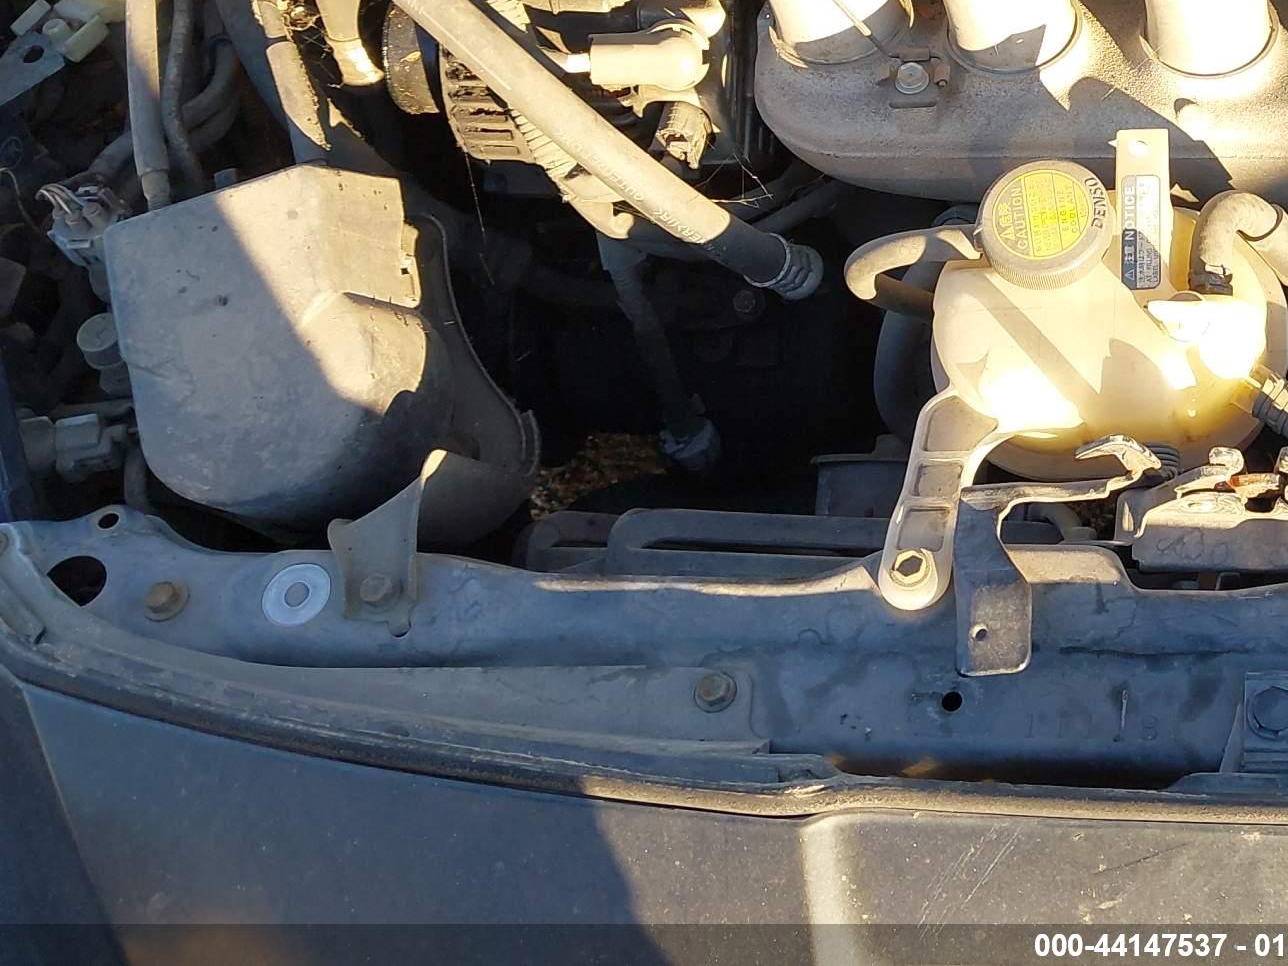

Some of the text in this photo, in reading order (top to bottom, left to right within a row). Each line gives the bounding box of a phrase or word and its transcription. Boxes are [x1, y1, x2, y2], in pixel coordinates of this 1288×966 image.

[1010, 187, 1028, 250] CAUTION
[1056, 188, 1070, 232] ENGINE
[1085, 177, 1106, 229] DENSO
[1124, 185, 1135, 241] NOTICE
